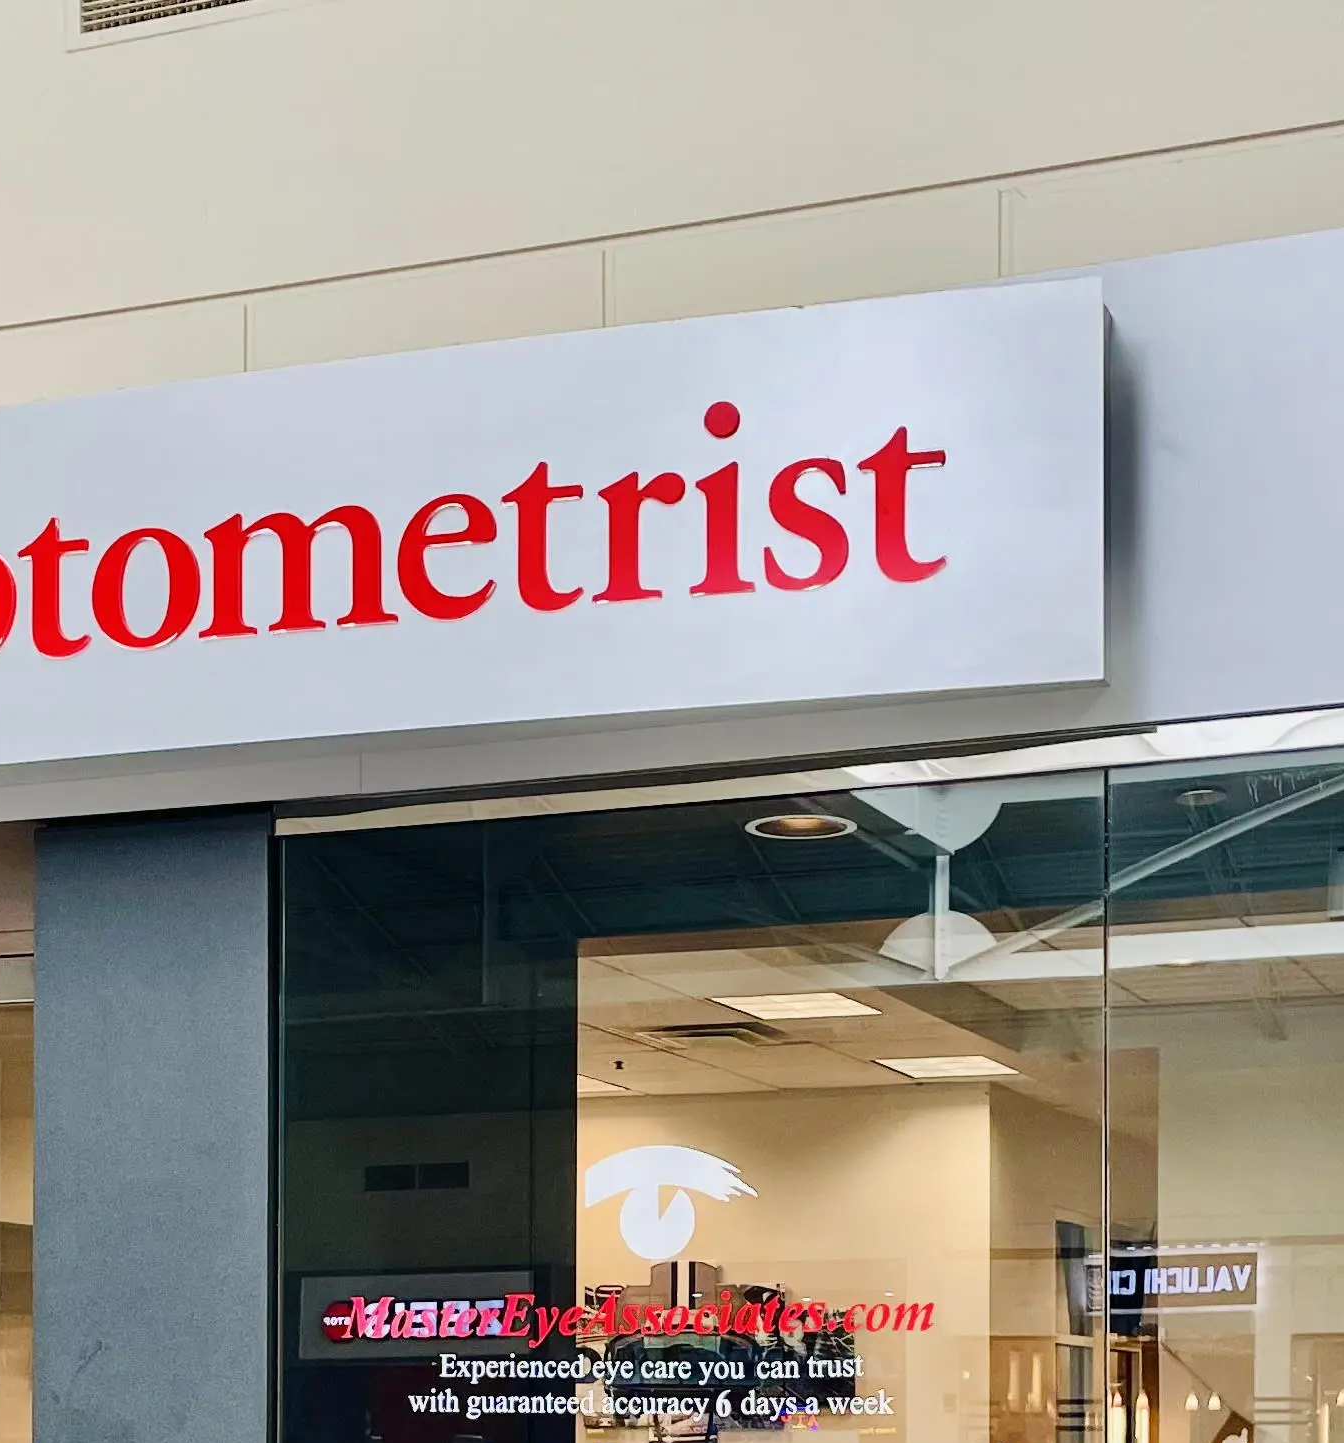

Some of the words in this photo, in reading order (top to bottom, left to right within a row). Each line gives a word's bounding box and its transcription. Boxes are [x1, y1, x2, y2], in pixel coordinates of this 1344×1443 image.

[342, 1289, 935, 1348] MasterEyeAssociates.com
[439, 1353, 586, 1384] Experienced
[592, 1360, 634, 1385] eye
[641, 1360, 692, 1379] care
[698, 1360, 745, 1385] you
[756, 1360, 800, 1379] can
[807, 1354, 865, 1379] trust
[408, 1388, 459, 1413] with
[465, 1390, 595, 1420] guaranteed
[601, 1394, 709, 1422] accuracy
[715, 1389, 732, 1418] 6
[740, 1389, 797, 1421] days
[805, 1396, 820, 1415] a
[826, 1388, 895, 1415] week
